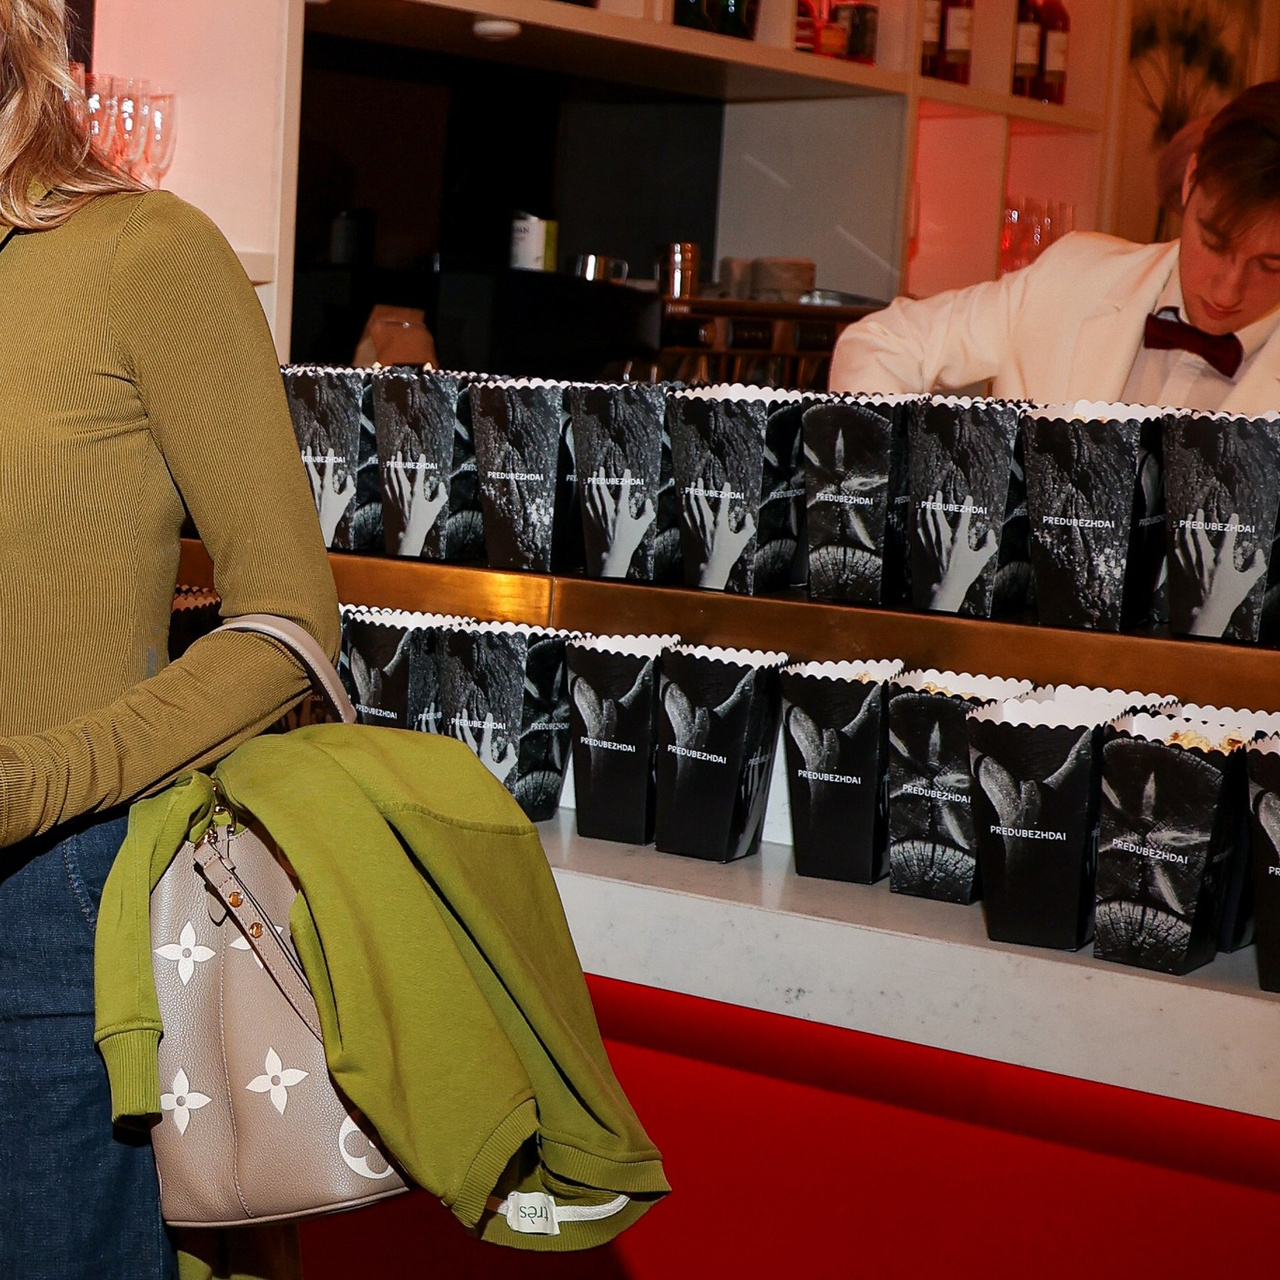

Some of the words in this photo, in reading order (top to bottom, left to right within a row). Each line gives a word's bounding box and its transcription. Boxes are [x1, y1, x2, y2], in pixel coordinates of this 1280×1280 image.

[386, 460, 438, 470] PREDUBEZHDAI
[487, 471, 544, 481] PREDUBEZHDAI
[587, 477, 645, 486] PREDUBEZHDAI
[684, 487, 745, 500] PREDUBEZHDAI
[816, 492, 874, 505] PREDUBEZHDAI
[921, 501, 988, 515] PREDUBEZHDAI
[1042, 515, 1115, 529] PREDUBEZHDAI
[1179, 520, 1256, 534] PREDUBEZHDAI
[355, 703, 398, 720] PREDUBEZHDAI
[451, 717, 506, 730] PREDUBEZHDAI
[580, 736, 636, 753] PREDUBEZHDAI
[667, 744, 727, 764] PREDUBEZHDAI
[797, 769, 861, 785] PREDUBEZHDAI
[902, 783, 971, 803] PREDUBEZHDAI
[989, 825, 1067, 841] PREDUBEZHDAI
[1111, 838, 1189, 864] PREDUBEZHDAI
[520, 1206, 549, 1225] très
